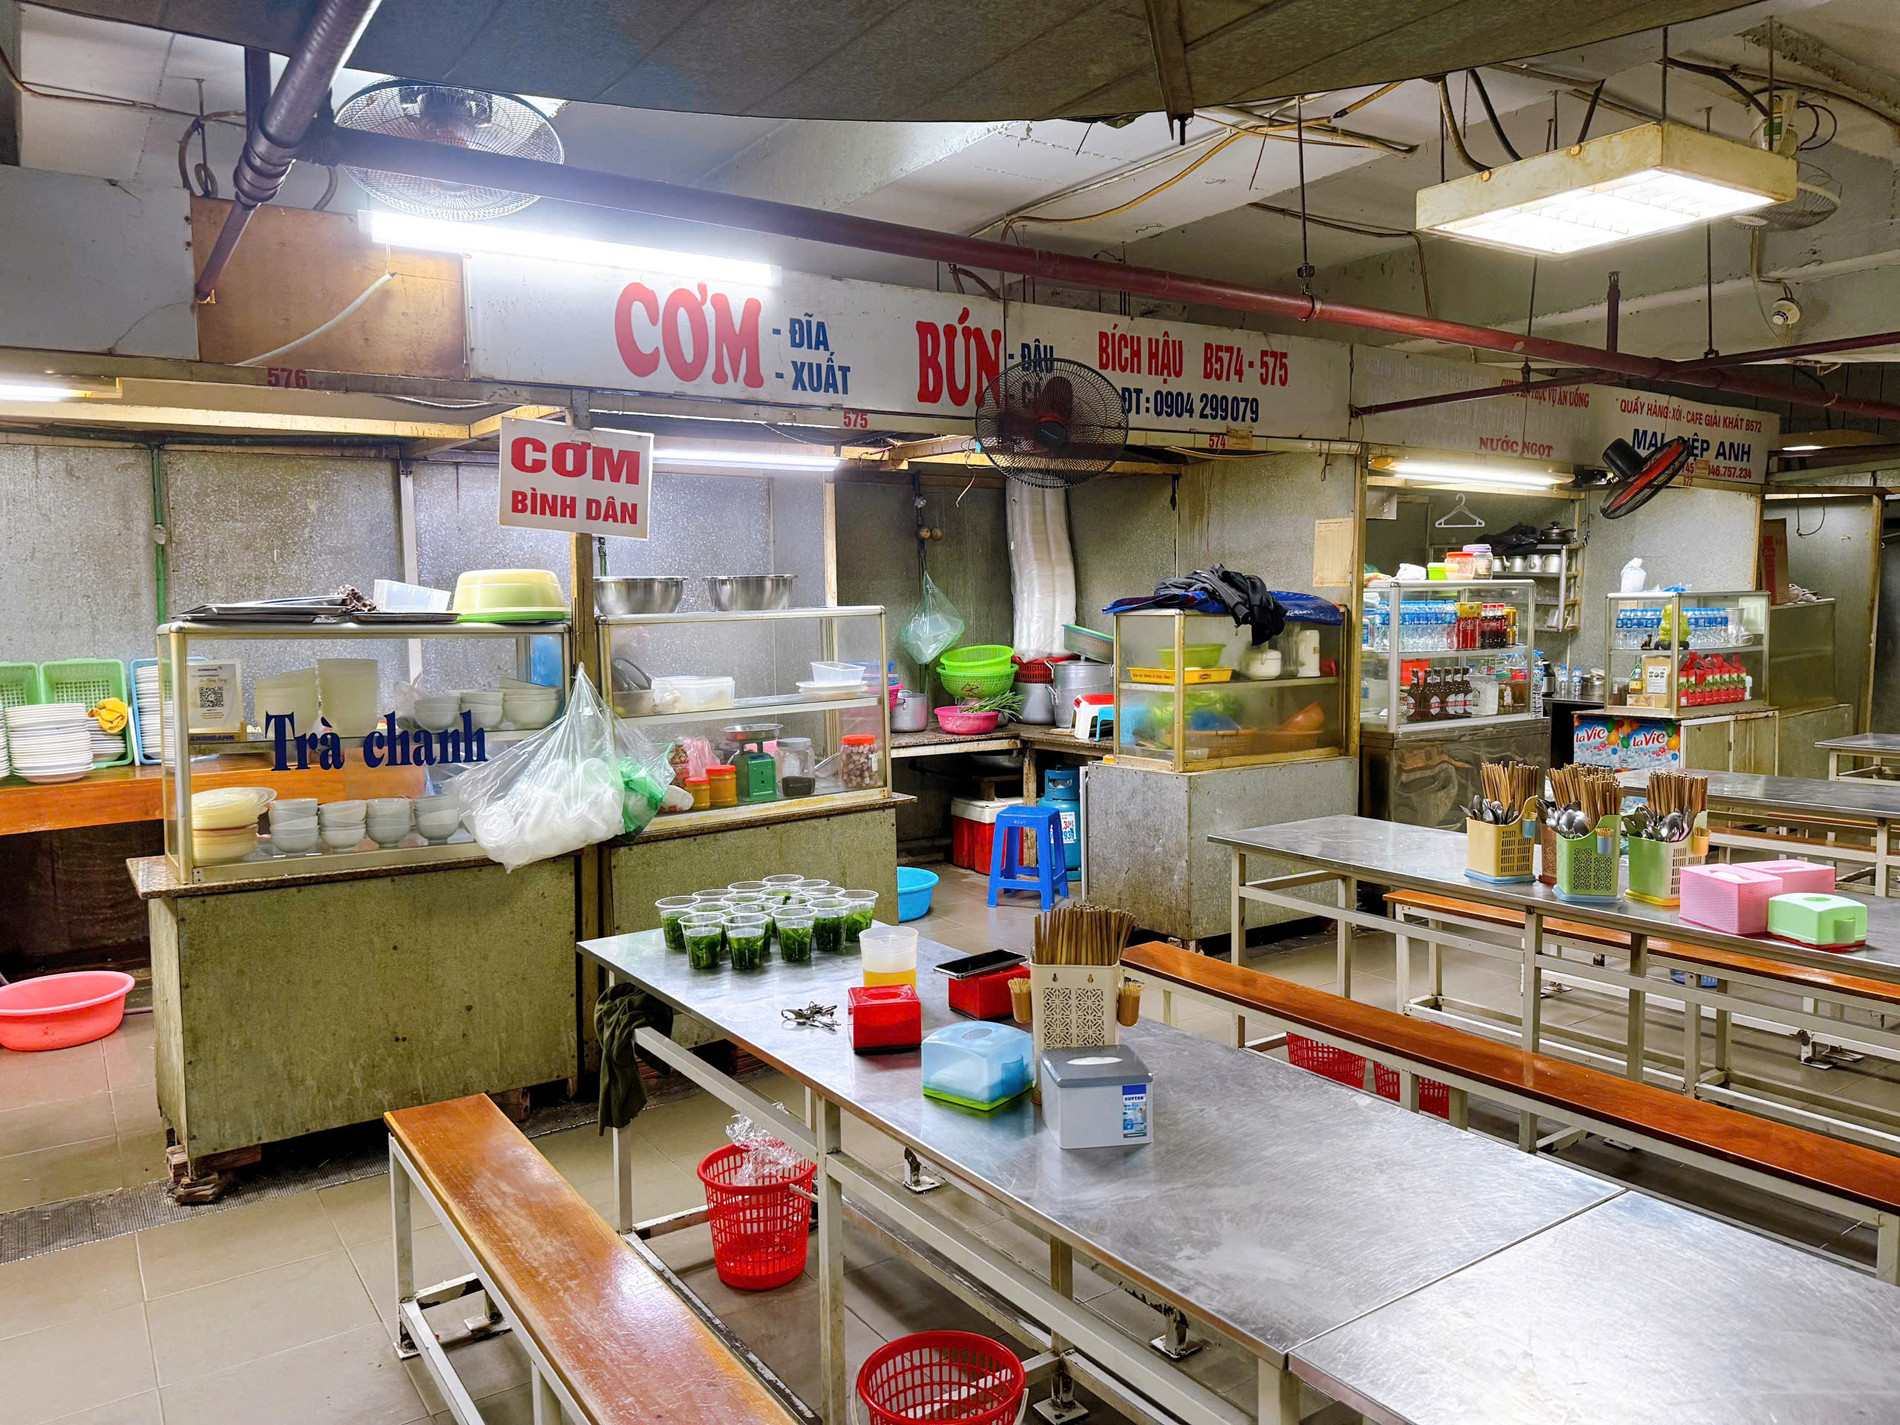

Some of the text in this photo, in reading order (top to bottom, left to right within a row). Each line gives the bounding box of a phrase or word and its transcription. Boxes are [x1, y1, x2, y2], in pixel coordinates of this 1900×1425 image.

[614, 281, 765, 390] CƠM
[788, 312, 830, 352] ĐĨA
[791, 352, 851, 395] XUẤT
[915, 306, 1002, 407] BÚN
[1098, 323, 1289, 387] BÍCH HẬU B574 575
[267, 367, 308, 389] 576
[842, 410, 869, 429] 575
[1153, 389, 1195, 419] 0904
[1199, 392, 1260, 423] 299079
[1686, 410, 1703, 426] CAFE
[1722, 413, 1745, 430] KHÁT
[1745, 418, 1762, 433] B572
[510, 436, 641, 486] CƠM
[1208, 434, 1226, 449] 574
[1478, 434, 1519, 454] NƯỚC
[1521, 440, 1554, 459] NGỌT
[1714, 440, 1751, 463] ANH
[510, 487, 638, 526] BÌNH DÂN
[265, 709, 489, 772] Trà chanh
